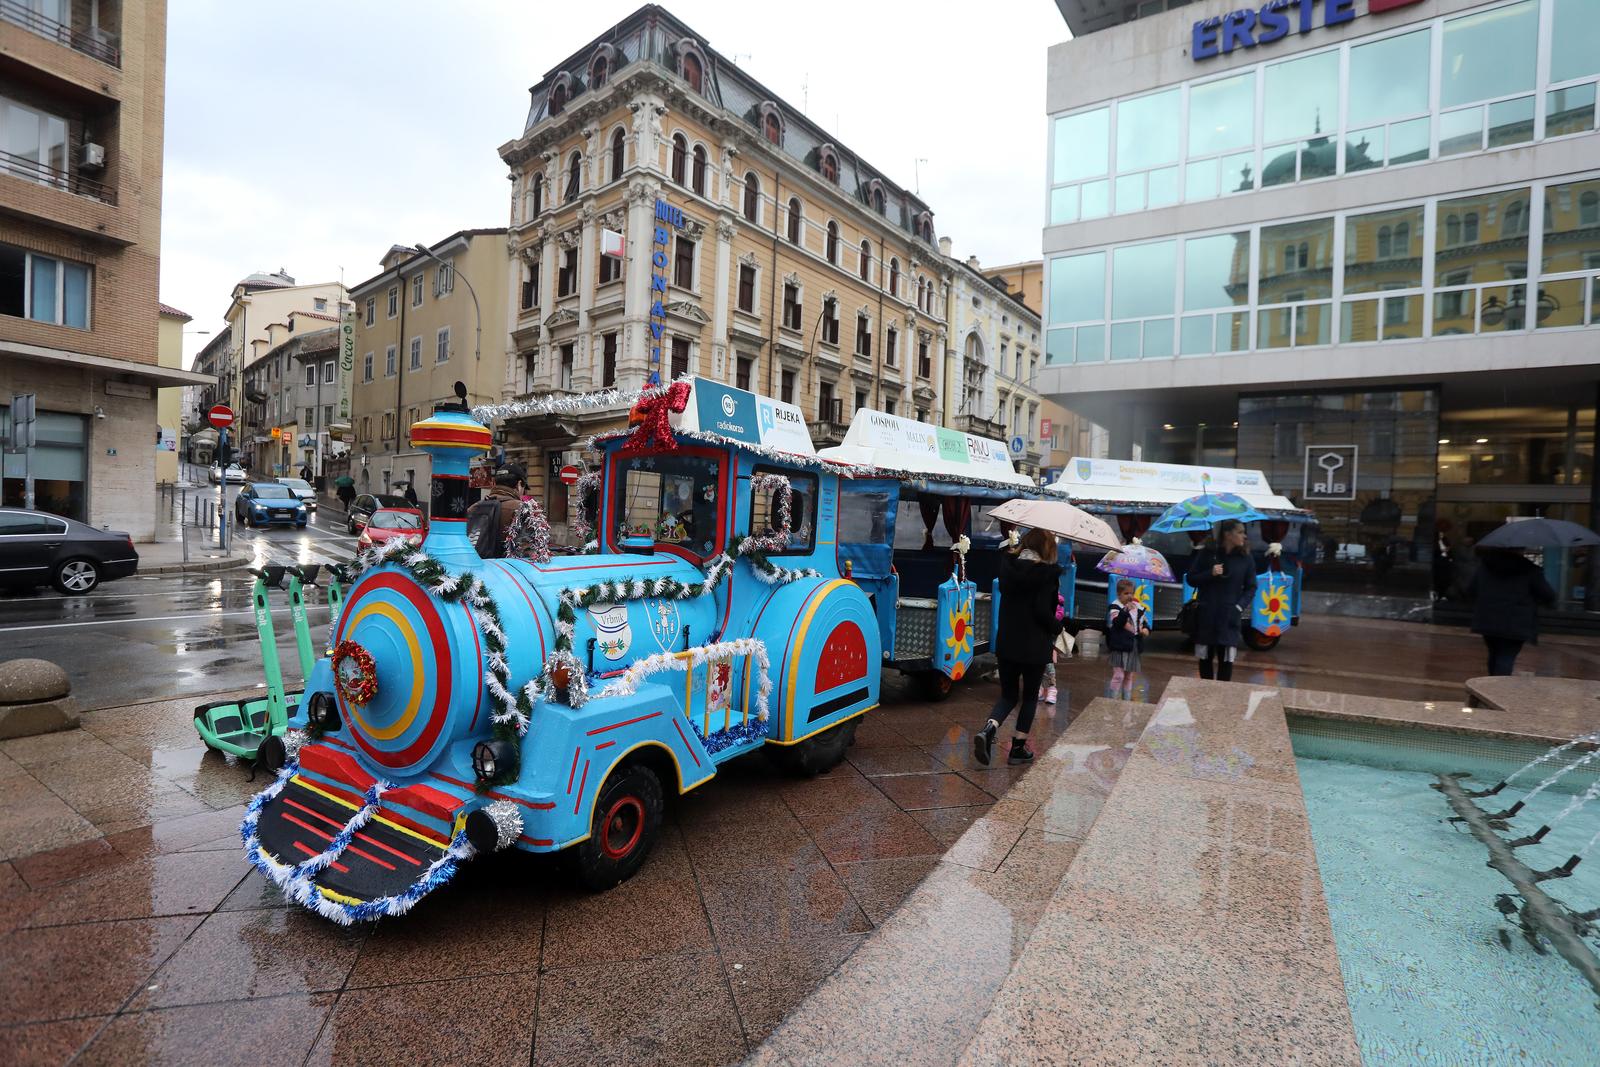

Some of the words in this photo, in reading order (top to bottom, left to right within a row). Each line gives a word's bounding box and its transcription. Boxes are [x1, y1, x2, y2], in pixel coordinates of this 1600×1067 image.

[1192, 0, 1356, 61] ERSTE
[655, 200, 684, 229] HOTEL
[650, 226, 669, 386] BONAVIA
[341, 337, 354, 372] Cocco
[775, 407, 801, 425] RIJEKA
[293, 605, 304, 623] Bolt
